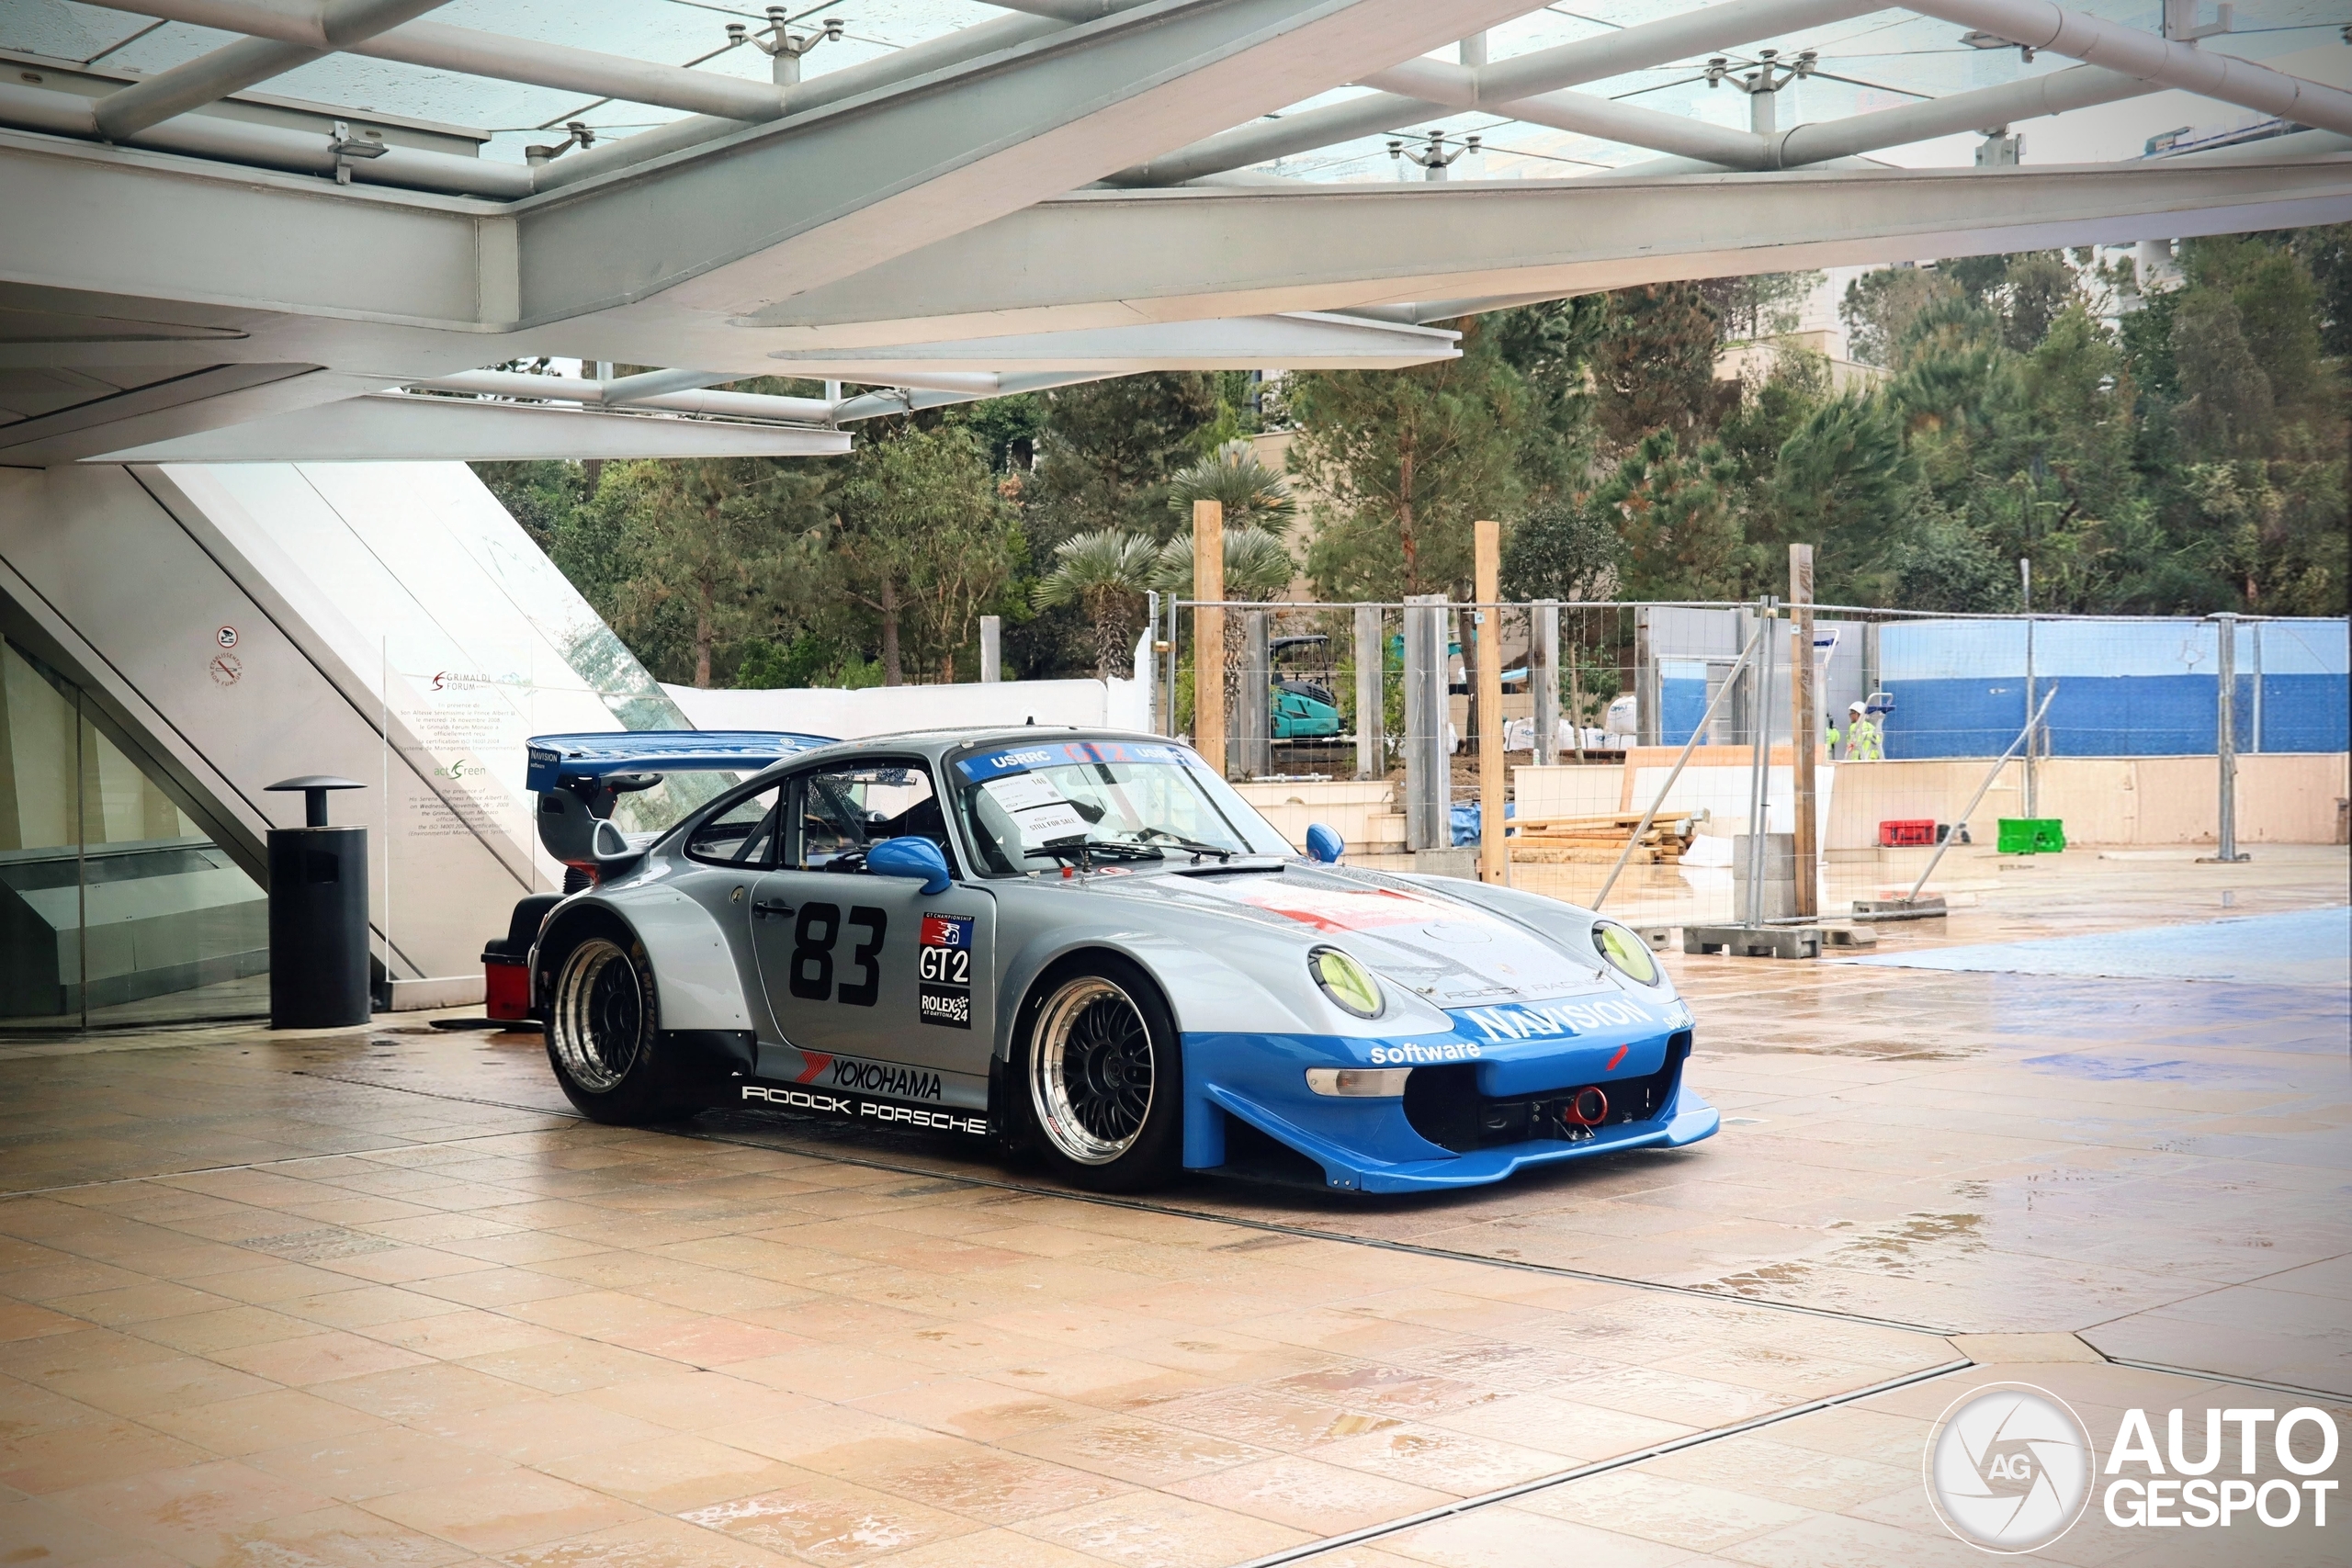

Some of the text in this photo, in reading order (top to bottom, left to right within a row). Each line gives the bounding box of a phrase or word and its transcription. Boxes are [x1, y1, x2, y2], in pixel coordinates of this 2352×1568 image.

[447, 673, 492, 682] GRIMALDI
[447, 682, 476, 691] FORUM
[990, 750, 1052, 768] USRRC
[1063, 743, 1134, 762] GT2
[1136, 747, 1187, 761] USRRC
[434, 767, 449, 776] act
[1031, 778, 1047, 786] 146
[1029, 822, 1047, 831] STILL
[933, 913, 972, 921] CHAMPIONSHIP
[789, 901, 888, 1007] 83
[920, 946, 969, 983] GT2
[922, 995, 956, 1013] ROLEX
[930, 1010, 953, 1019] DAYTONA
[953, 1008, 968, 1022] 24
[1464, 998, 1654, 1043] NAVISION
[1371, 1041, 1481, 1065] software
[832, 1058, 942, 1100] YOKOHAMA
[741, 1086, 988, 1135] ROOCK PORSCHE
